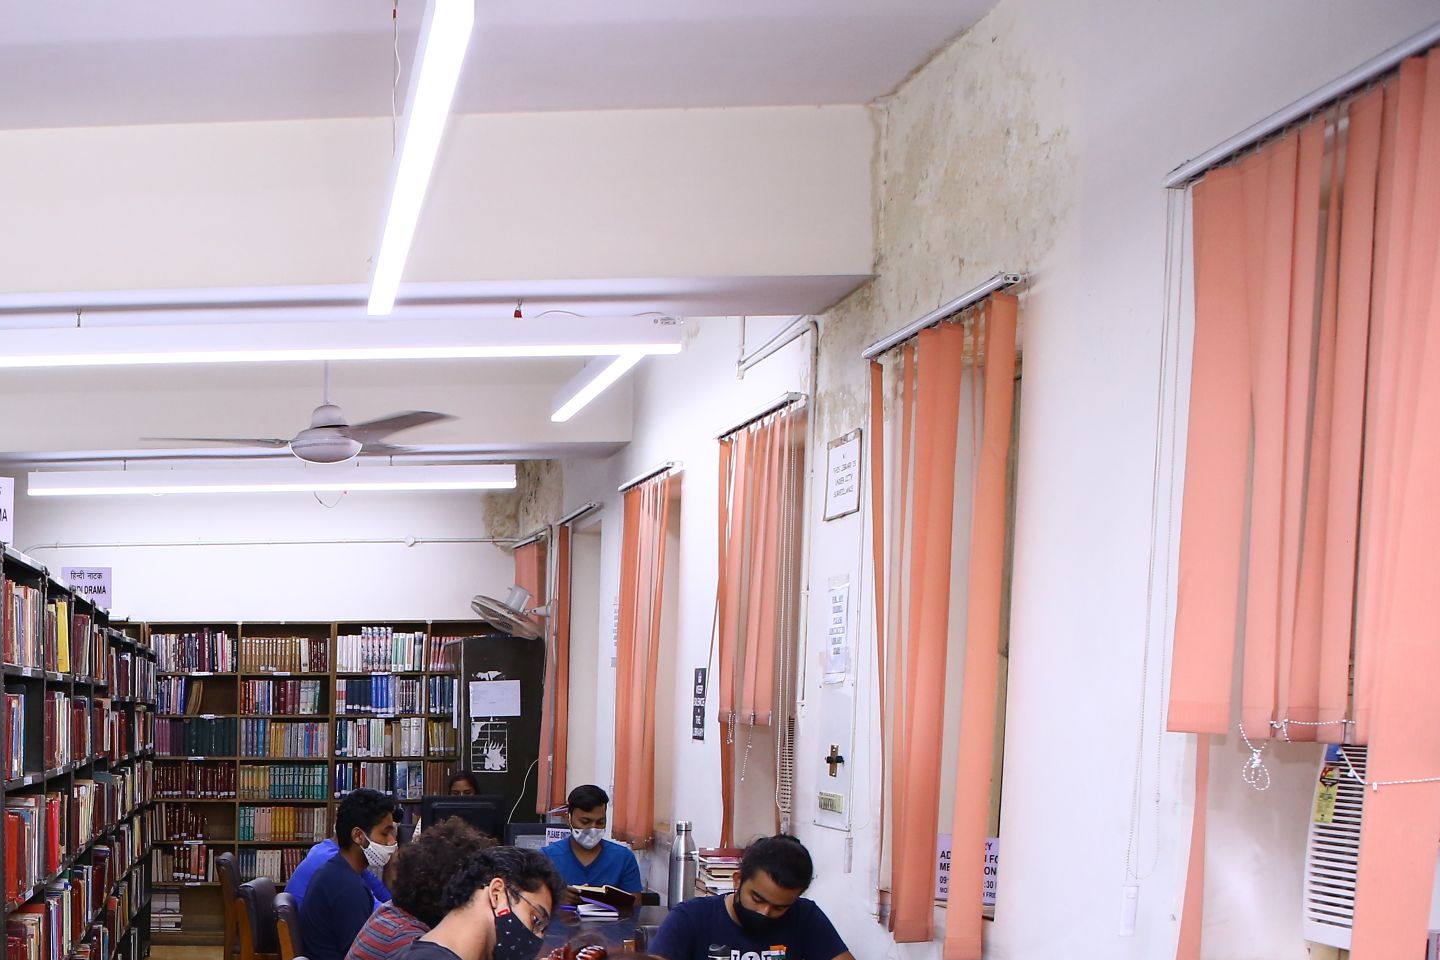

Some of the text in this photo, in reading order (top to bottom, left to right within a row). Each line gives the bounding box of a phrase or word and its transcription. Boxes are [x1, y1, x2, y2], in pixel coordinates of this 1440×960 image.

[70, 570, 103, 580] हिन्दी नाटक
[84, 585, 106, 595] DRAMA
[989, 855, 998, 864] FO
